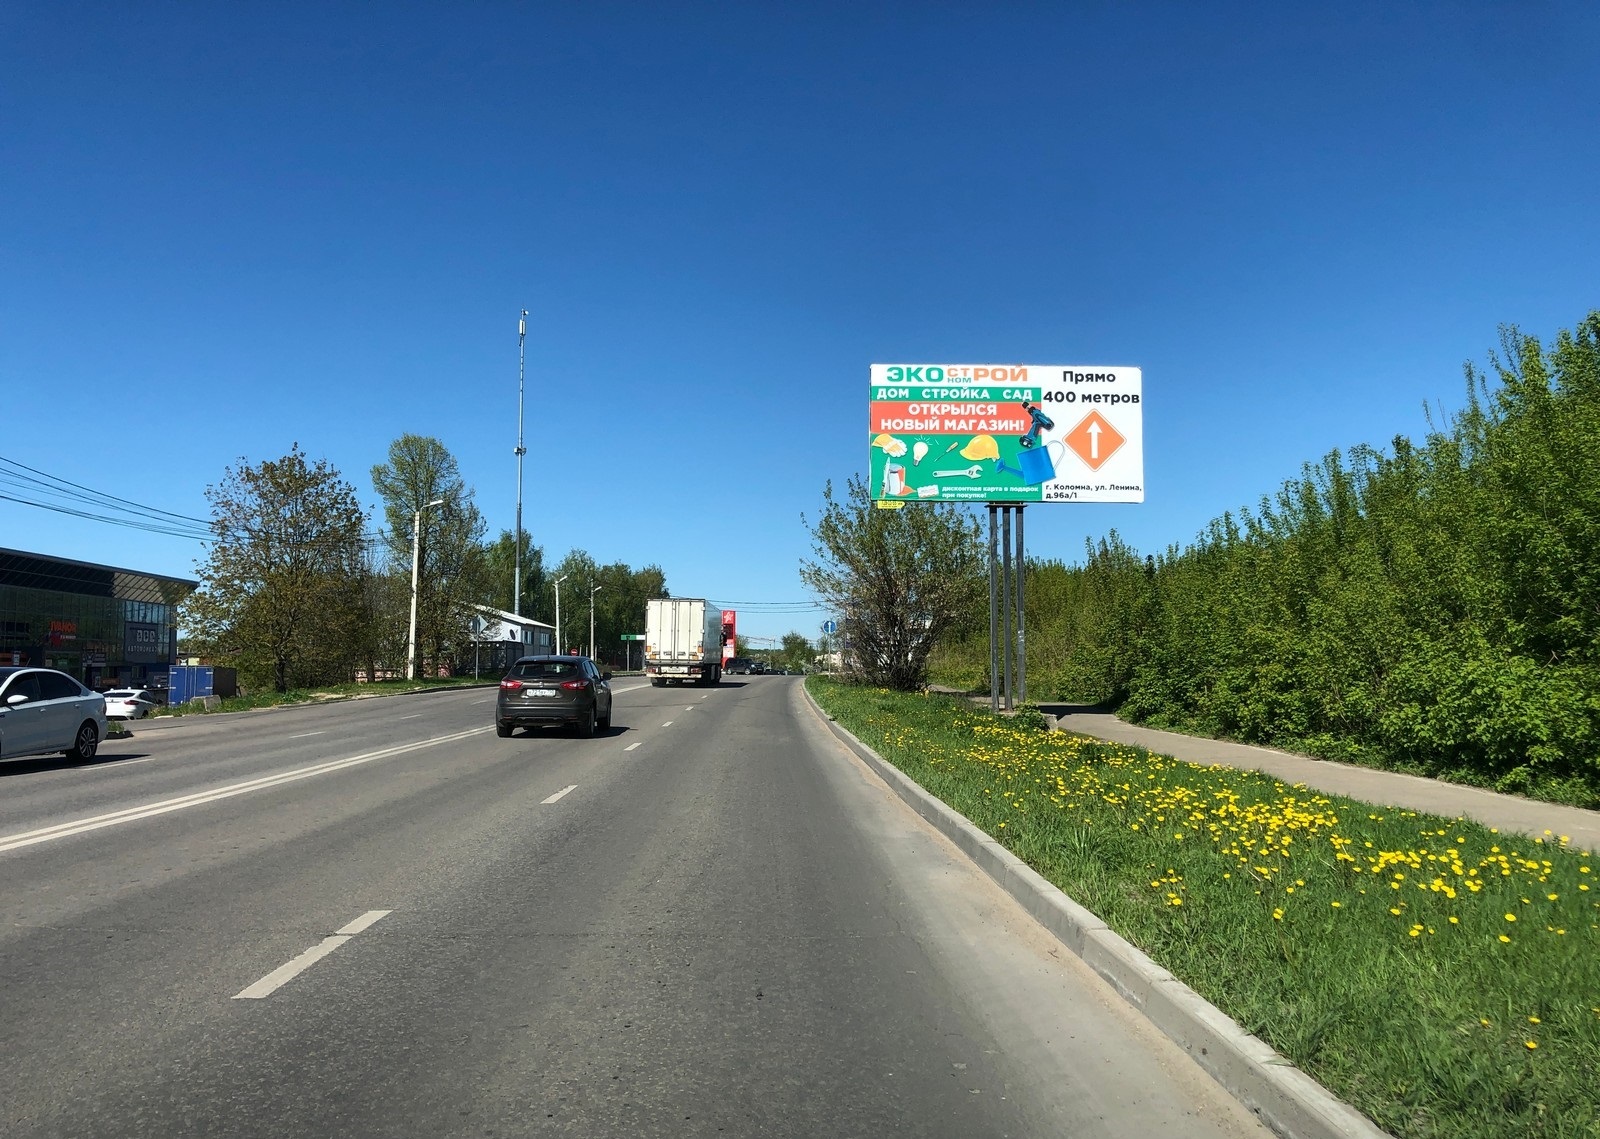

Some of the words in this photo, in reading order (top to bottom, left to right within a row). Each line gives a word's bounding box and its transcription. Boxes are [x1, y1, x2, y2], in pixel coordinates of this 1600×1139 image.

[1063, 370, 1116, 385] Прямо
[876, 388, 910, 400] ДОМ
[921, 387, 990, 399] СТРОЙКА
[1002, 389, 1033, 401] САД
[1043, 391, 1076, 403] 400
[1081, 393, 1140, 405] метров
[908, 404, 997, 416] ОТКРЫЛСЯ
[880, 416, 940, 431] НОВЫЙ
[944, 419, 1025, 431] МАГАЗИН!
